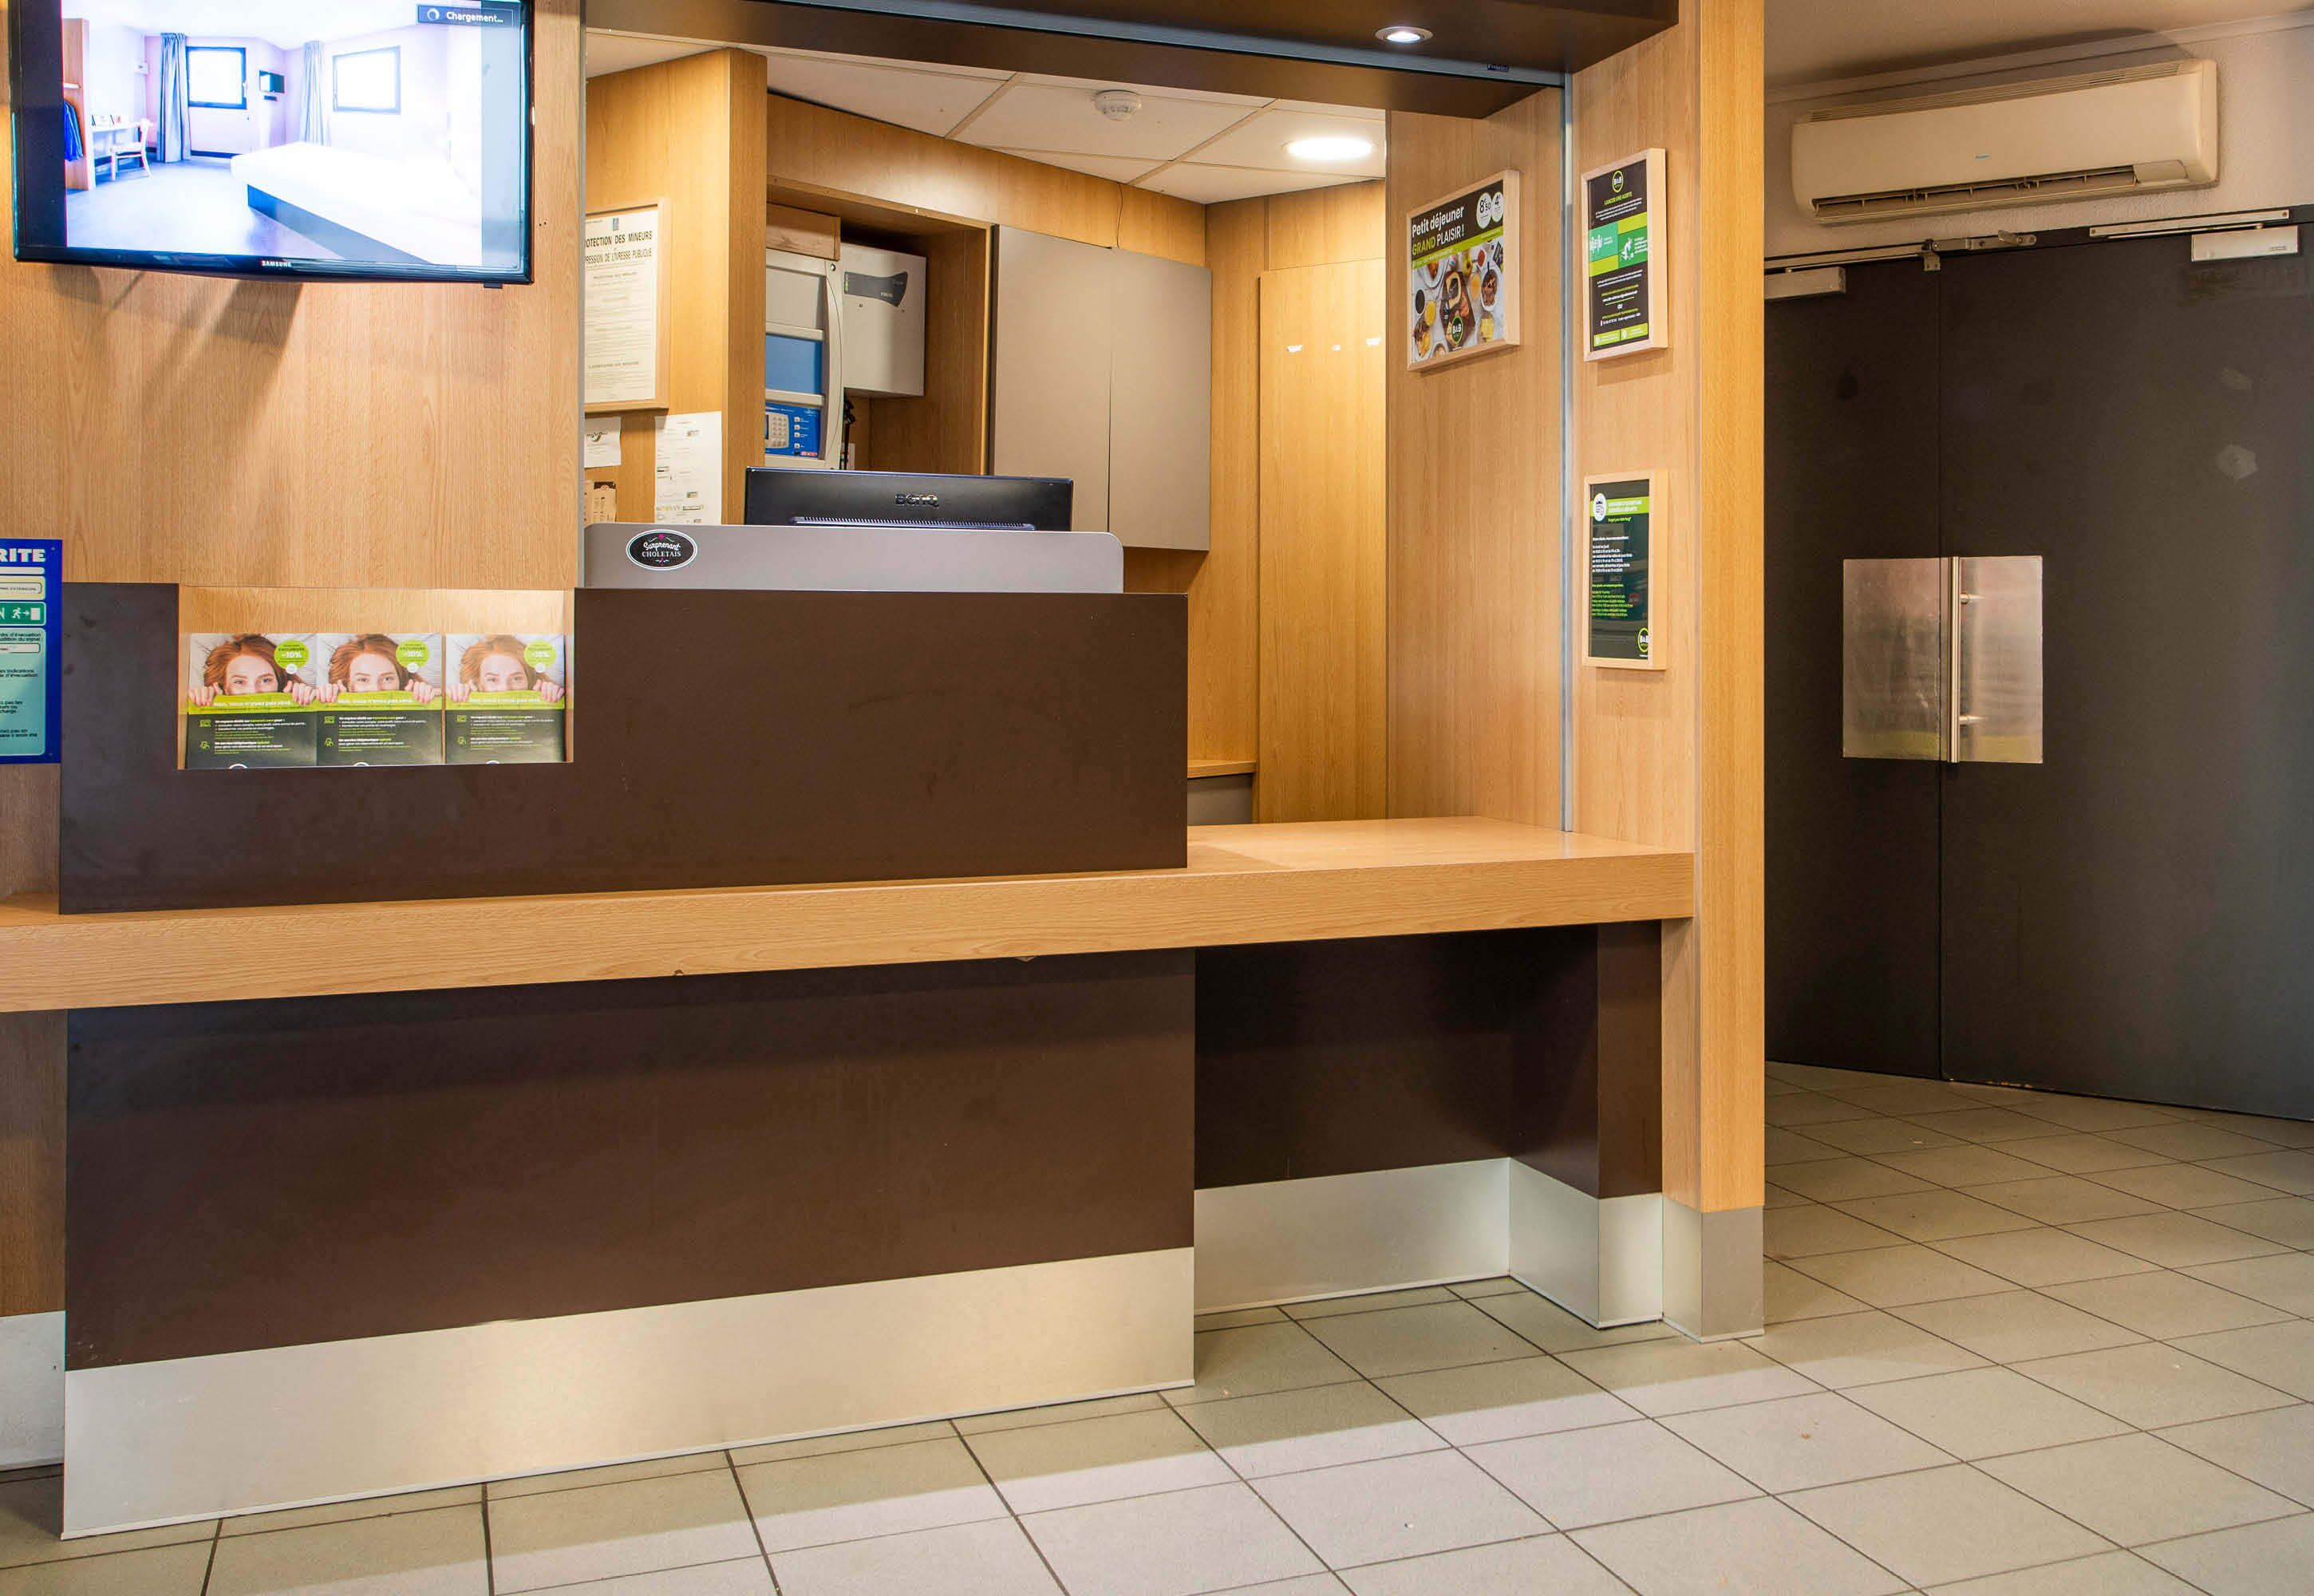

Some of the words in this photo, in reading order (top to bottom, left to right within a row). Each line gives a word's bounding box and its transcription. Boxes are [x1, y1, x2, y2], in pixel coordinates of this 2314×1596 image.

[1412, 218, 1429, 238] Petit
[1430, 206, 1465, 231] déjeuner
[586, 235, 612, 248] OTECTION
[614, 235, 626, 244] DES
[629, 231, 652, 243] MINEURS
[1412, 236, 1435, 256] GRAND
[261, 259, 293, 268] SAMSUNG
[643, 542, 681, 551] Surprenant
